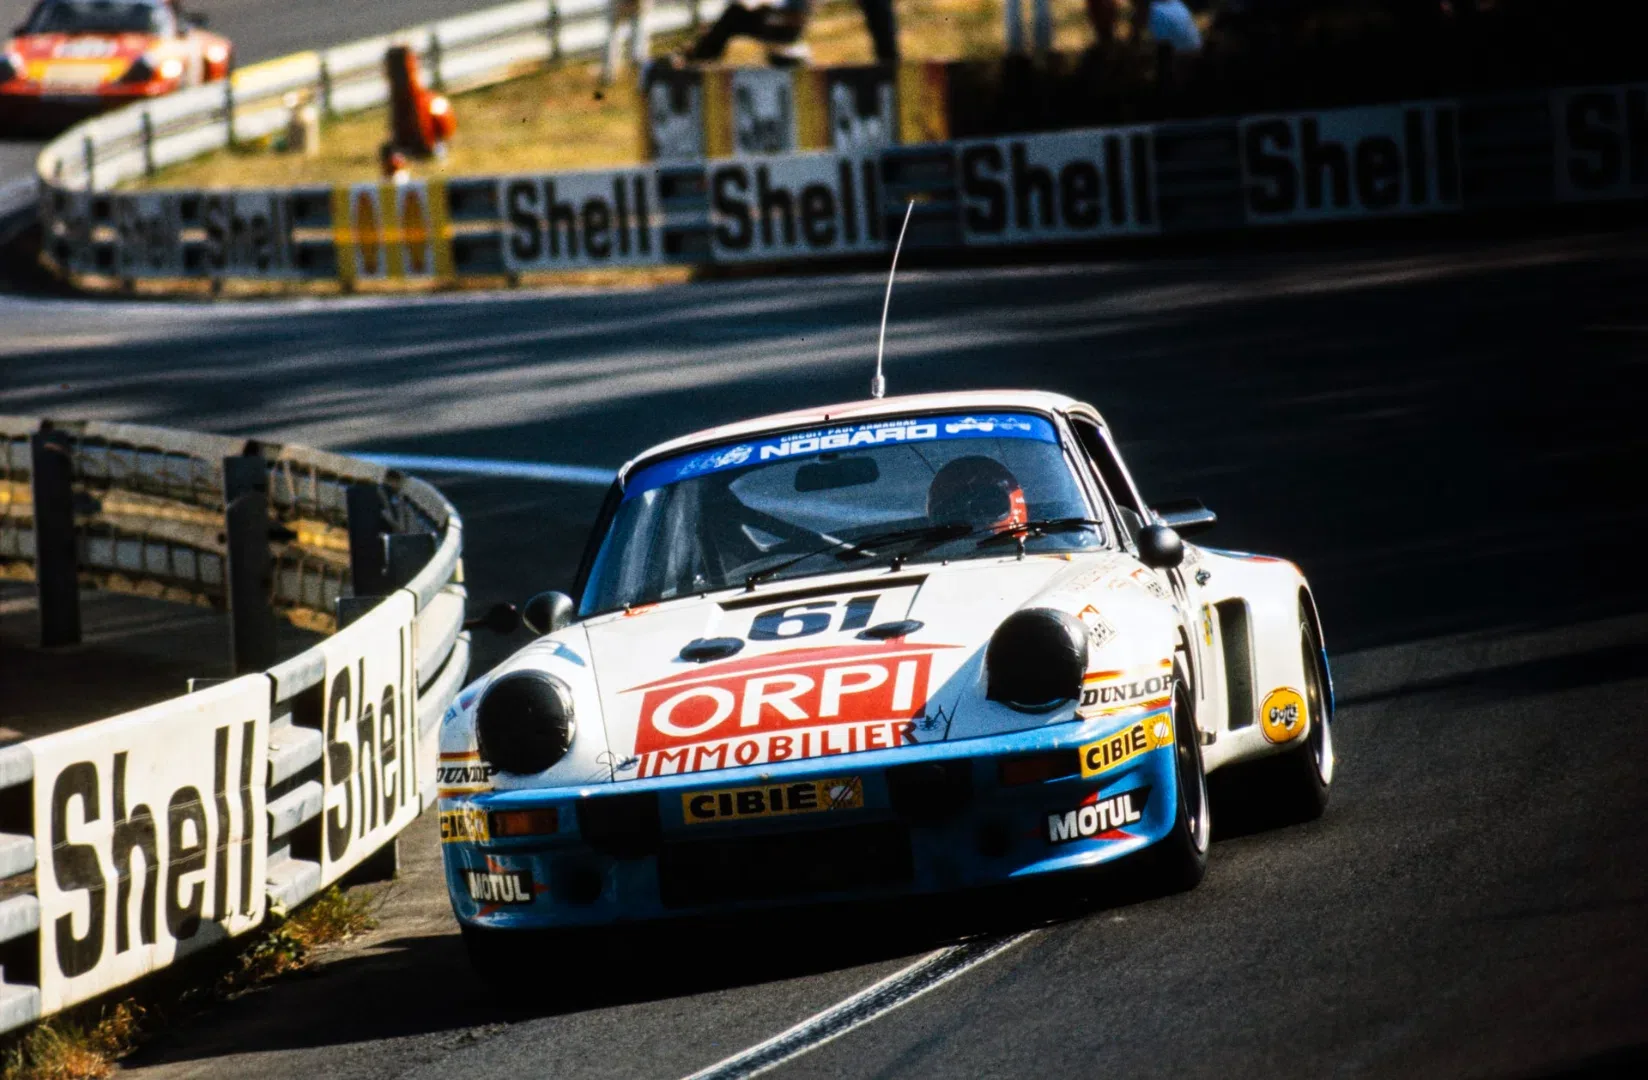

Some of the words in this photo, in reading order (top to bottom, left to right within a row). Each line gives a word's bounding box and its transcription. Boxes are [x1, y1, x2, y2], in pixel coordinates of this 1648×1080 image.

[960, 131, 1156, 234] Shell
[1245, 109, 1459, 214] Shell
[506, 176, 654, 261] Shell
[709, 159, 882, 251] Shell
[760, 424, 937, 460] NOGARO
[780, 431, 822, 442] CIRCUIT
[828, 427, 854, 435] PAUL
[748, 594, 881, 641] 61
[652, 660, 917, 737] ORPI
[1080, 674, 1174, 706] DUNLOP
[327, 619, 417, 863] Shell
[637, 721, 918, 778] IMMOBILIER
[1086, 724, 1147, 770] CIBIÉ
[1048, 794, 1140, 843] MOTUL
[51, 719, 256, 978] Shell
[468, 872, 530, 901] MOTUL
